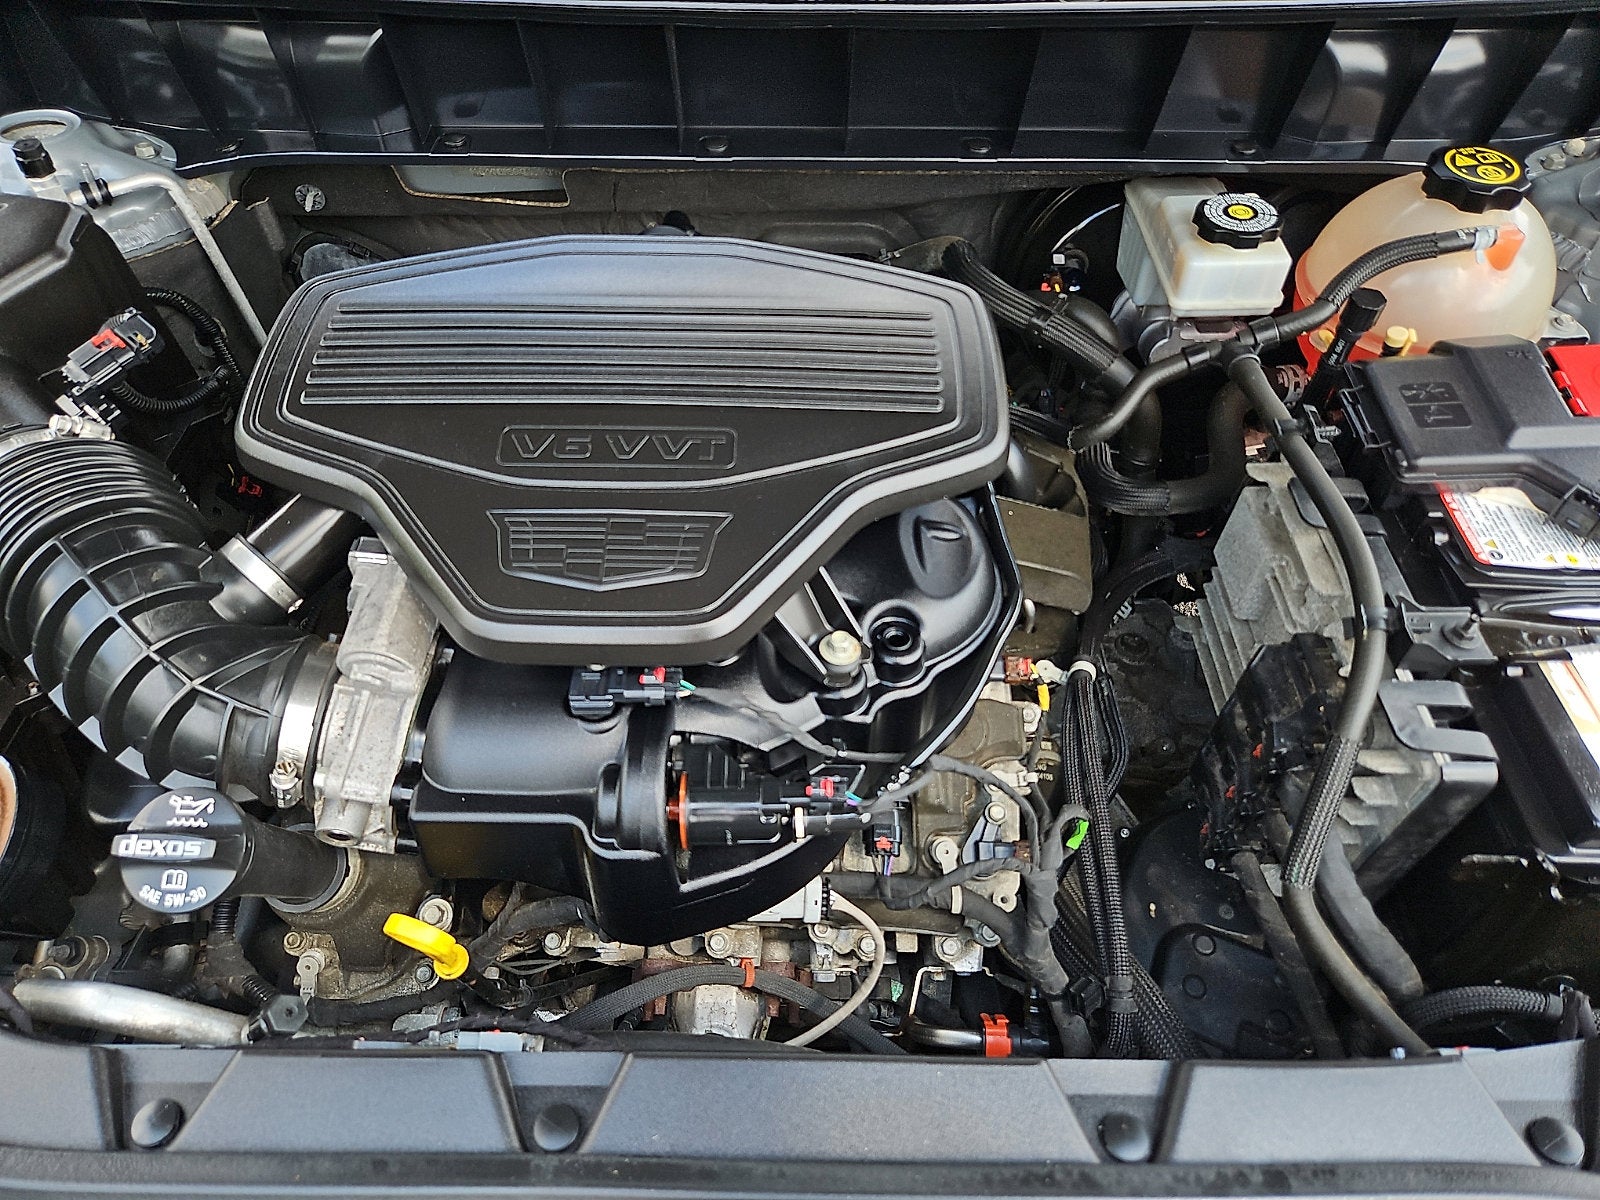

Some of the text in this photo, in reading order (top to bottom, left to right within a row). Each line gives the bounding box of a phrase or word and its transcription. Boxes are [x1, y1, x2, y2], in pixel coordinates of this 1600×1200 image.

[511, 433, 727, 461] V6 VVT
[118, 833, 202, 857] dexos
[139, 884, 207, 907] SAE 5W-30
